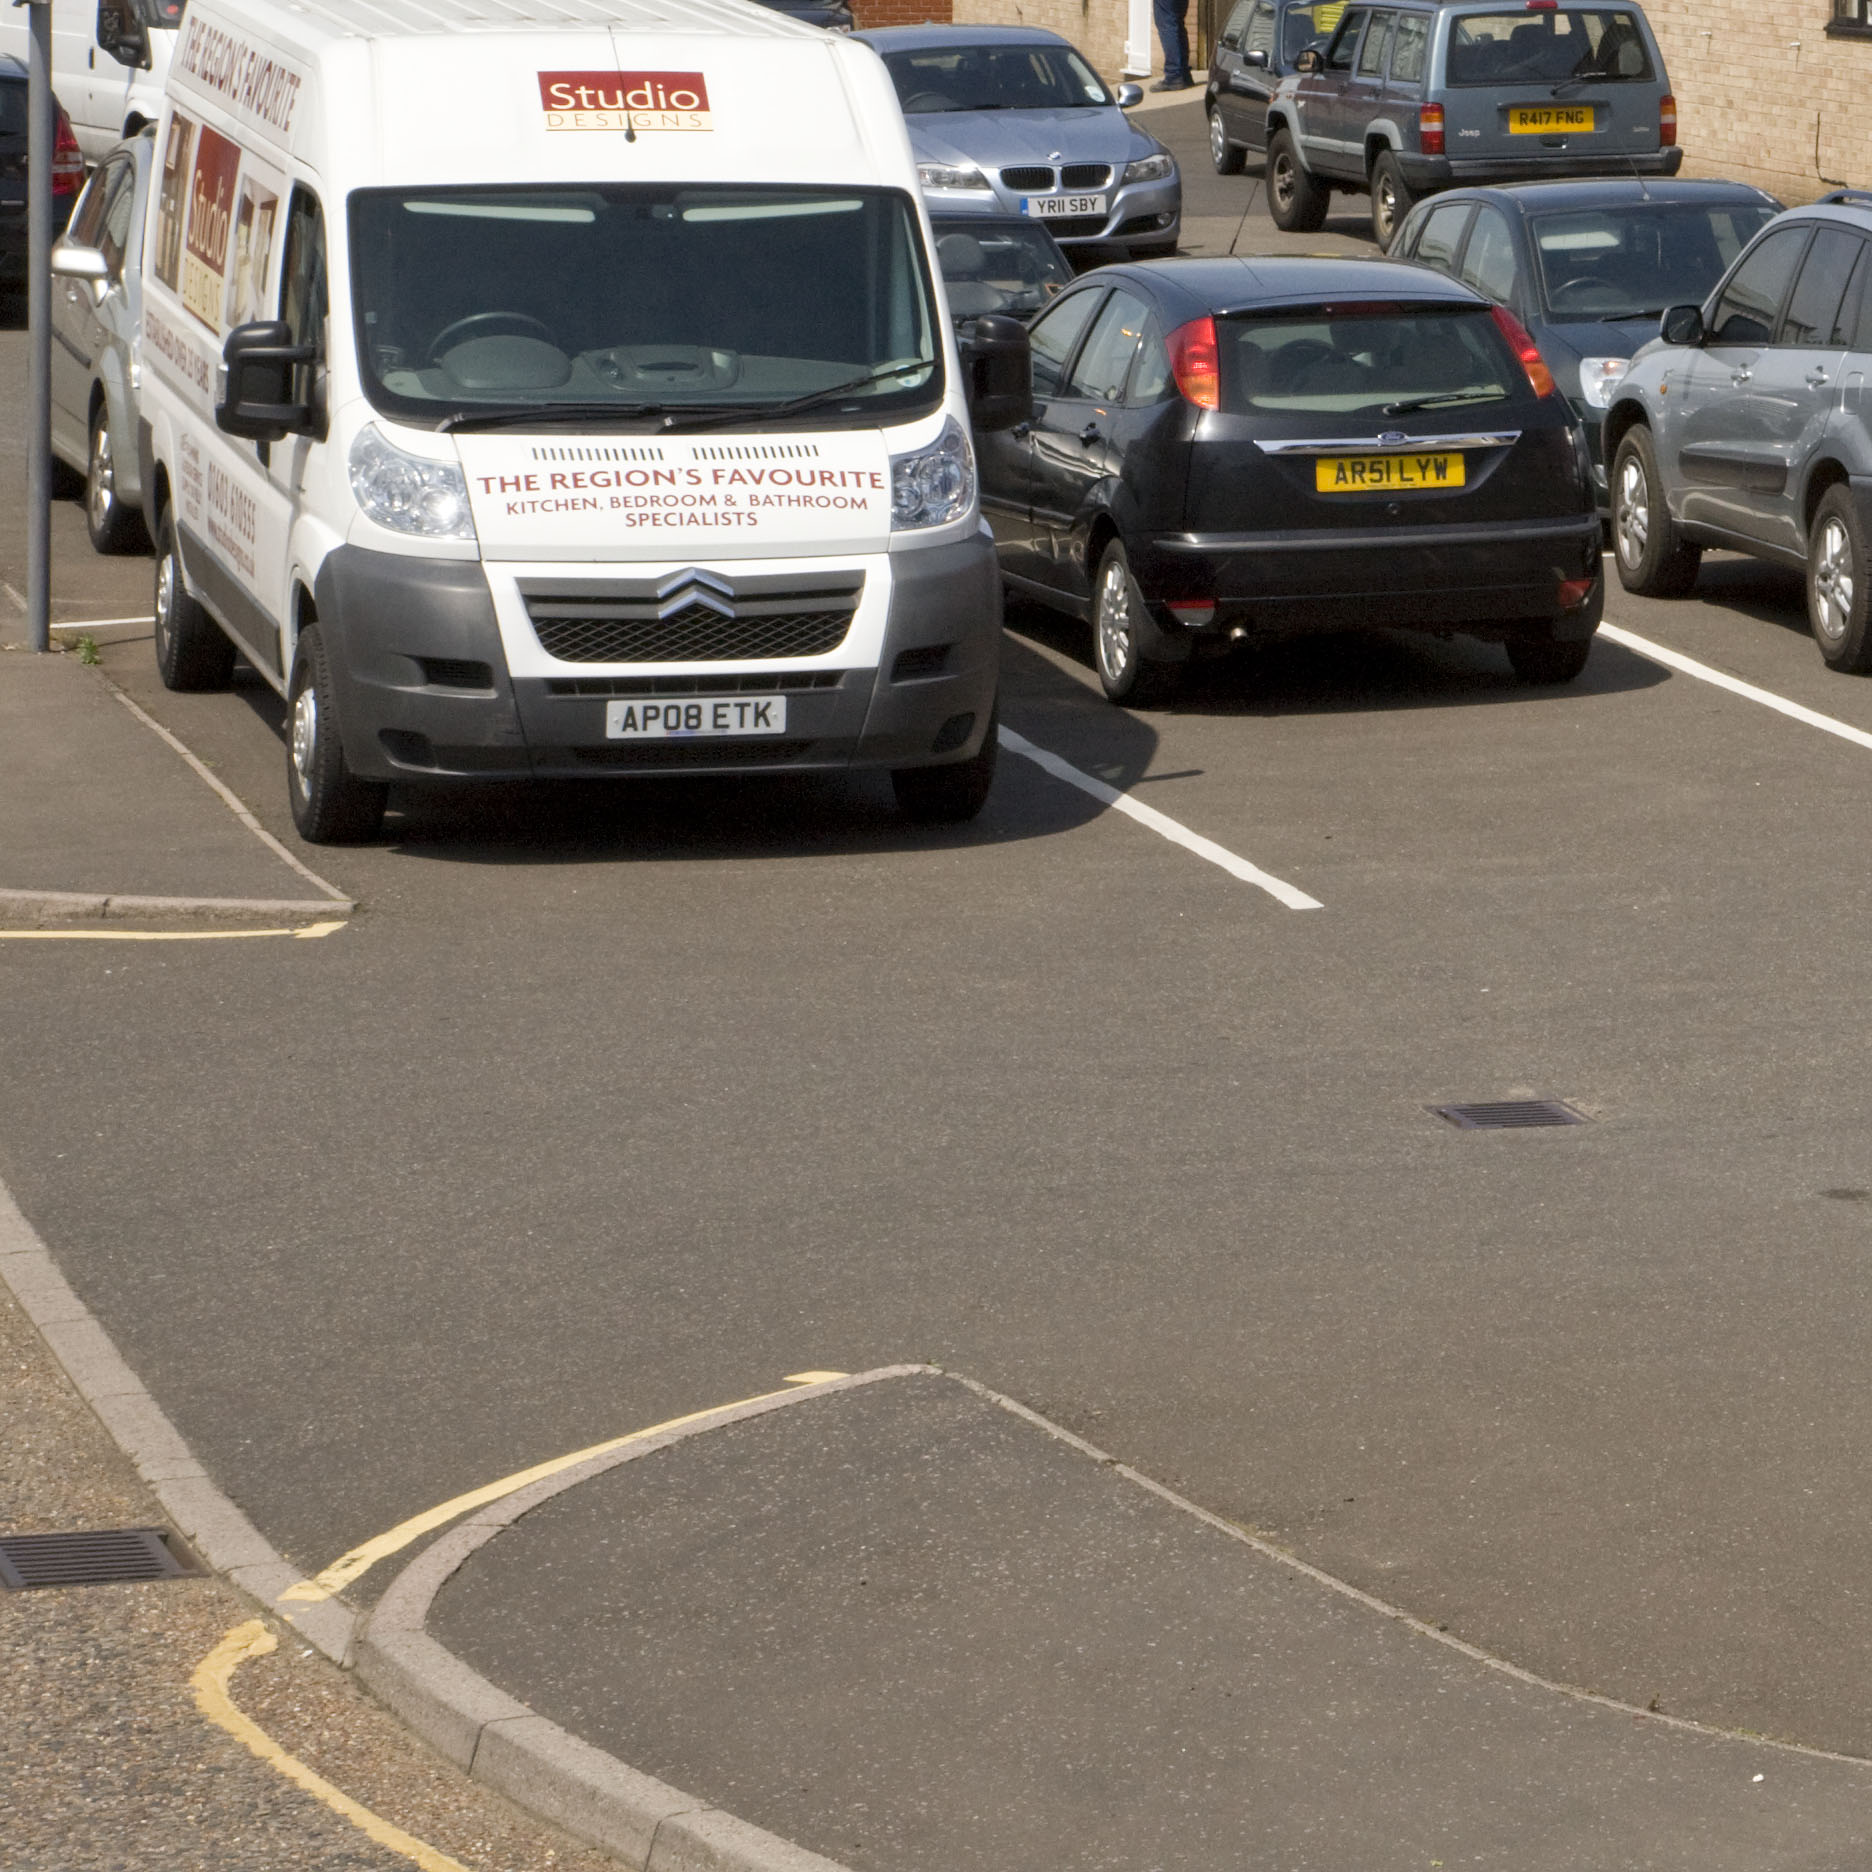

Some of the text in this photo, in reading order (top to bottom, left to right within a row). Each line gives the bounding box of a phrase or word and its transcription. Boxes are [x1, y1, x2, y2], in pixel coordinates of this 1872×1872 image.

[549, 81, 700, 110] Studio
[547, 113, 702, 127] DESIGNS
[1519, 110, 1584, 126] R417 FNG
[1037, 197, 1097, 214] YR11 SBY
[1335, 457, 1448, 485] AR51 LYW
[477, 468, 885, 495] THE REGION'S FAVOURITE
[610, 494, 717, 510] BEDROOM
[724, 494, 737, 507] &
[749, 494, 868, 511] BATHROOM
[625, 512, 758, 528] SPECIALISTS
[622, 701, 772, 732] AP08 ETK
